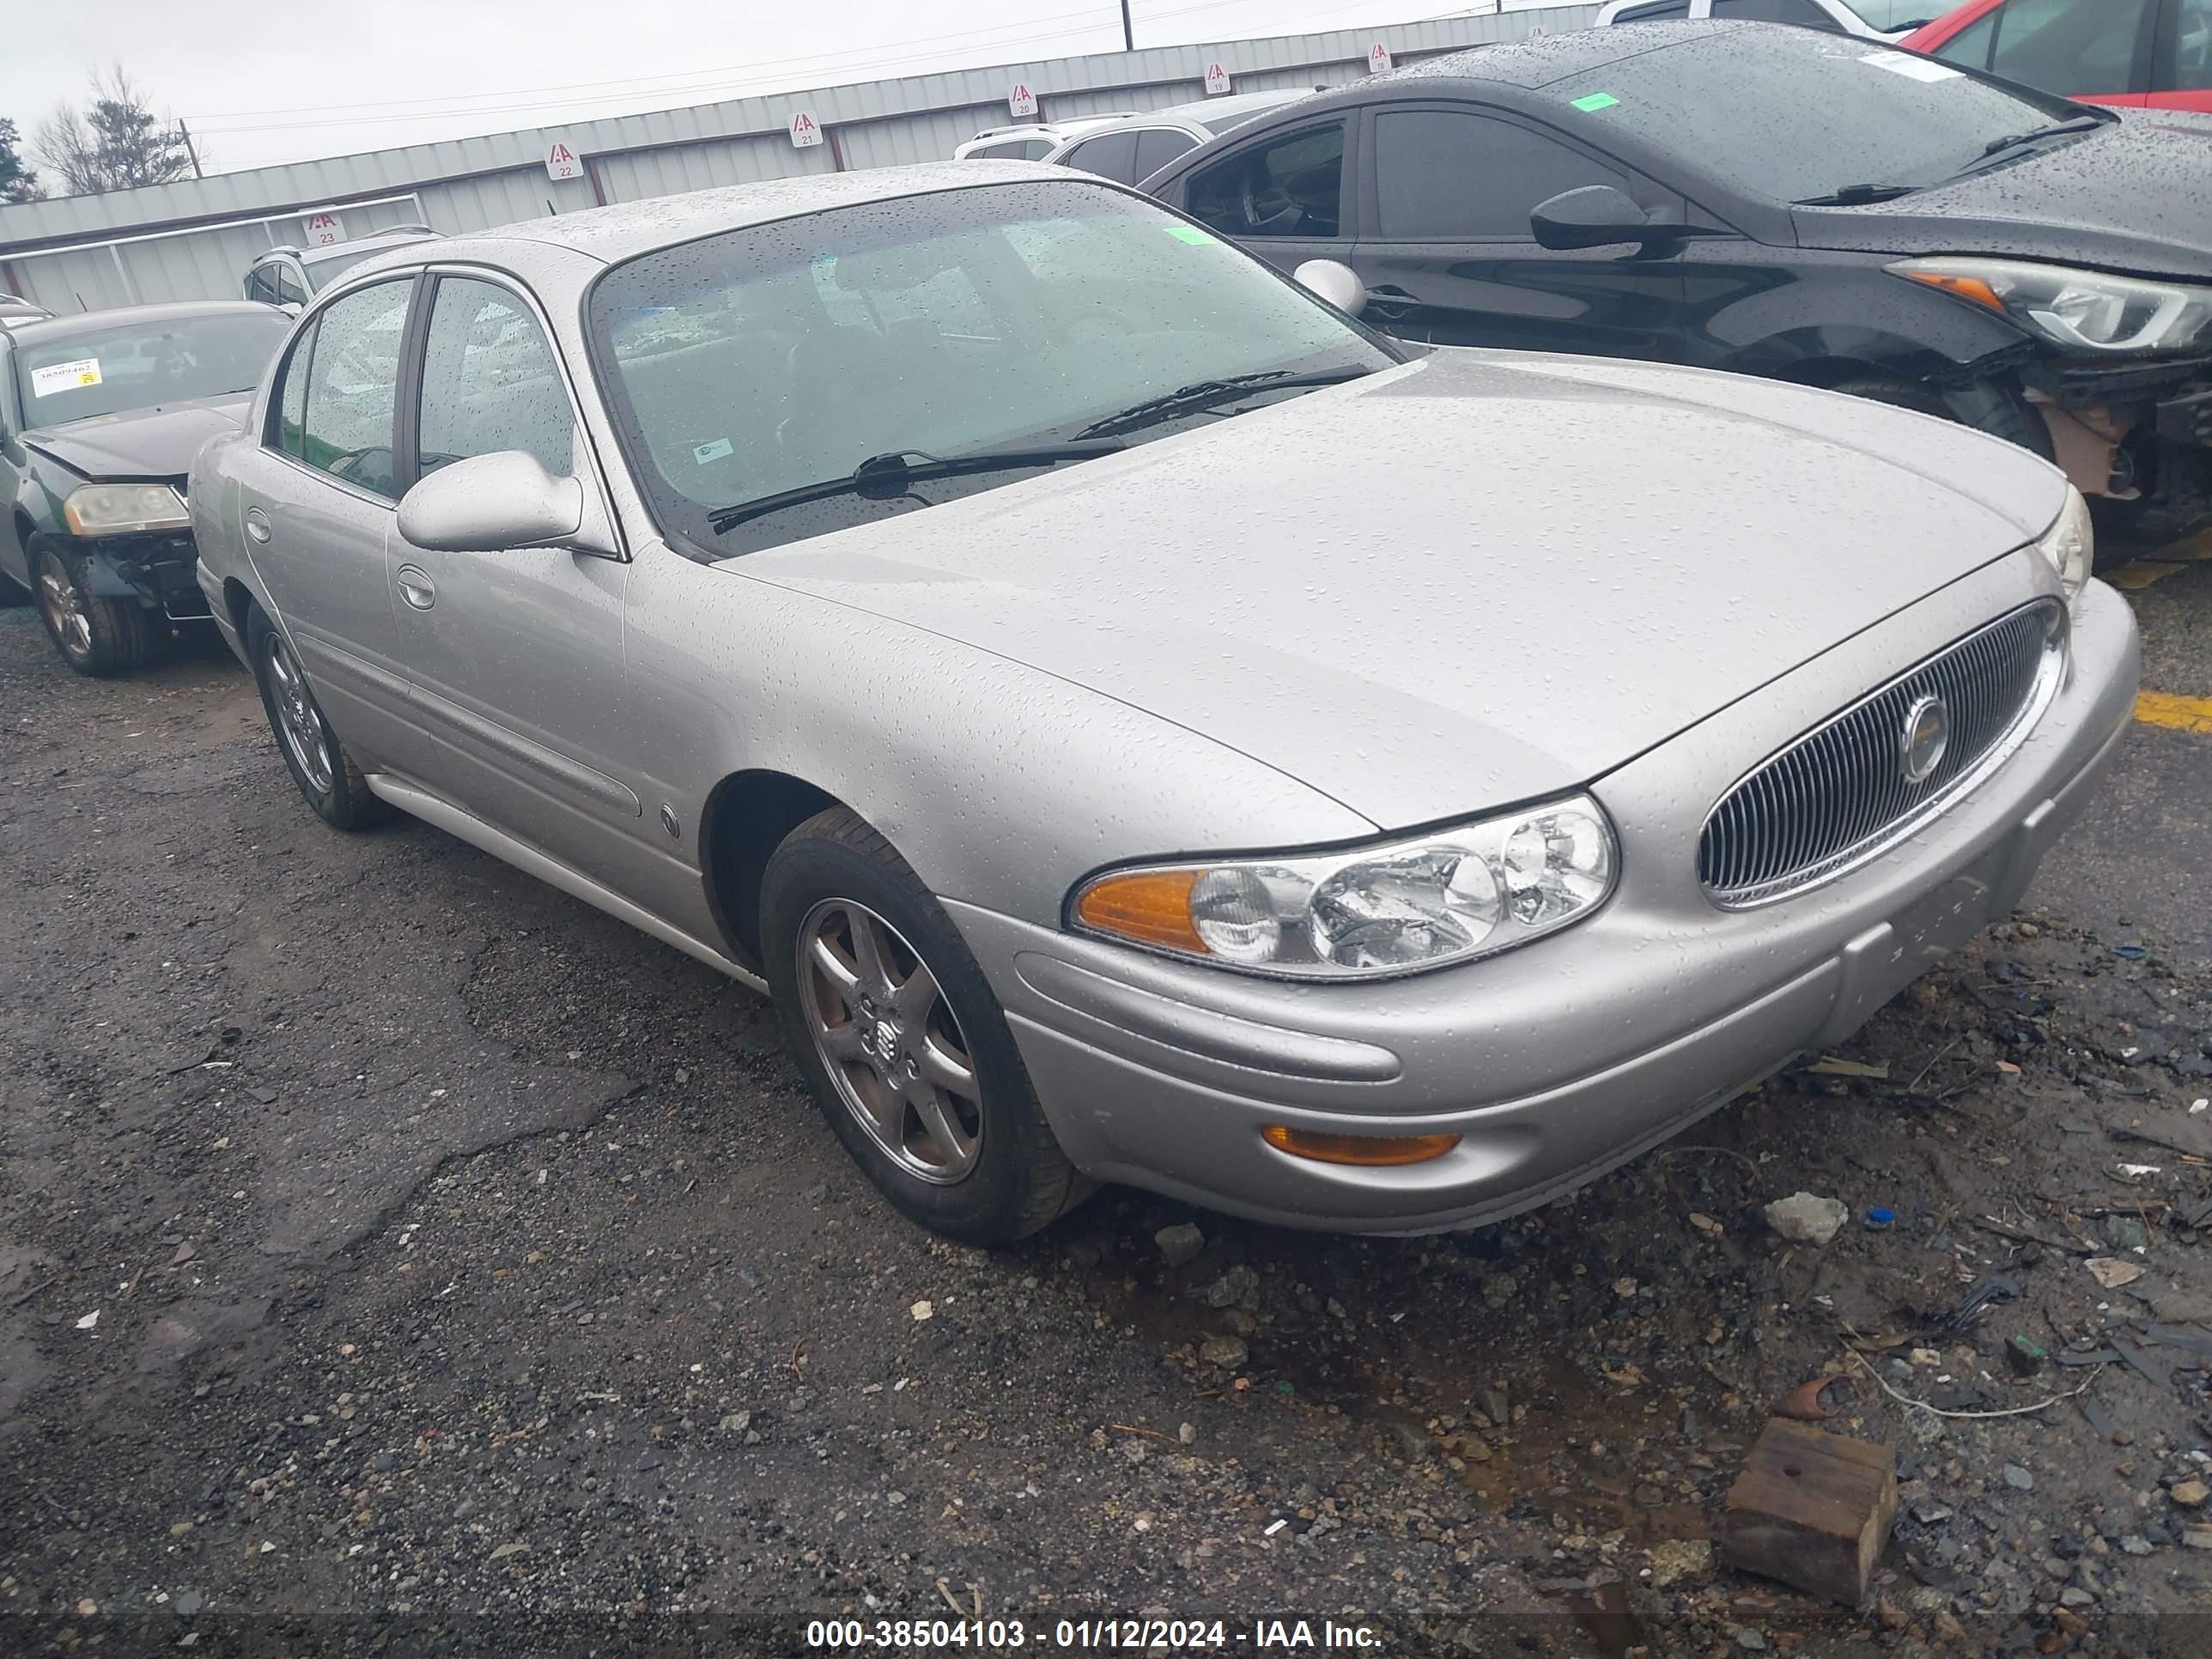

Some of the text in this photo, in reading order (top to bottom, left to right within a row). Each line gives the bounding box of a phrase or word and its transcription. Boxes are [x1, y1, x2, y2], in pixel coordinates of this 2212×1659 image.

[1019, 105, 1030, 113] 20
[802, 136, 812, 144] 21
[559, 167, 574, 177] 22
[319, 233, 335, 244] 23
